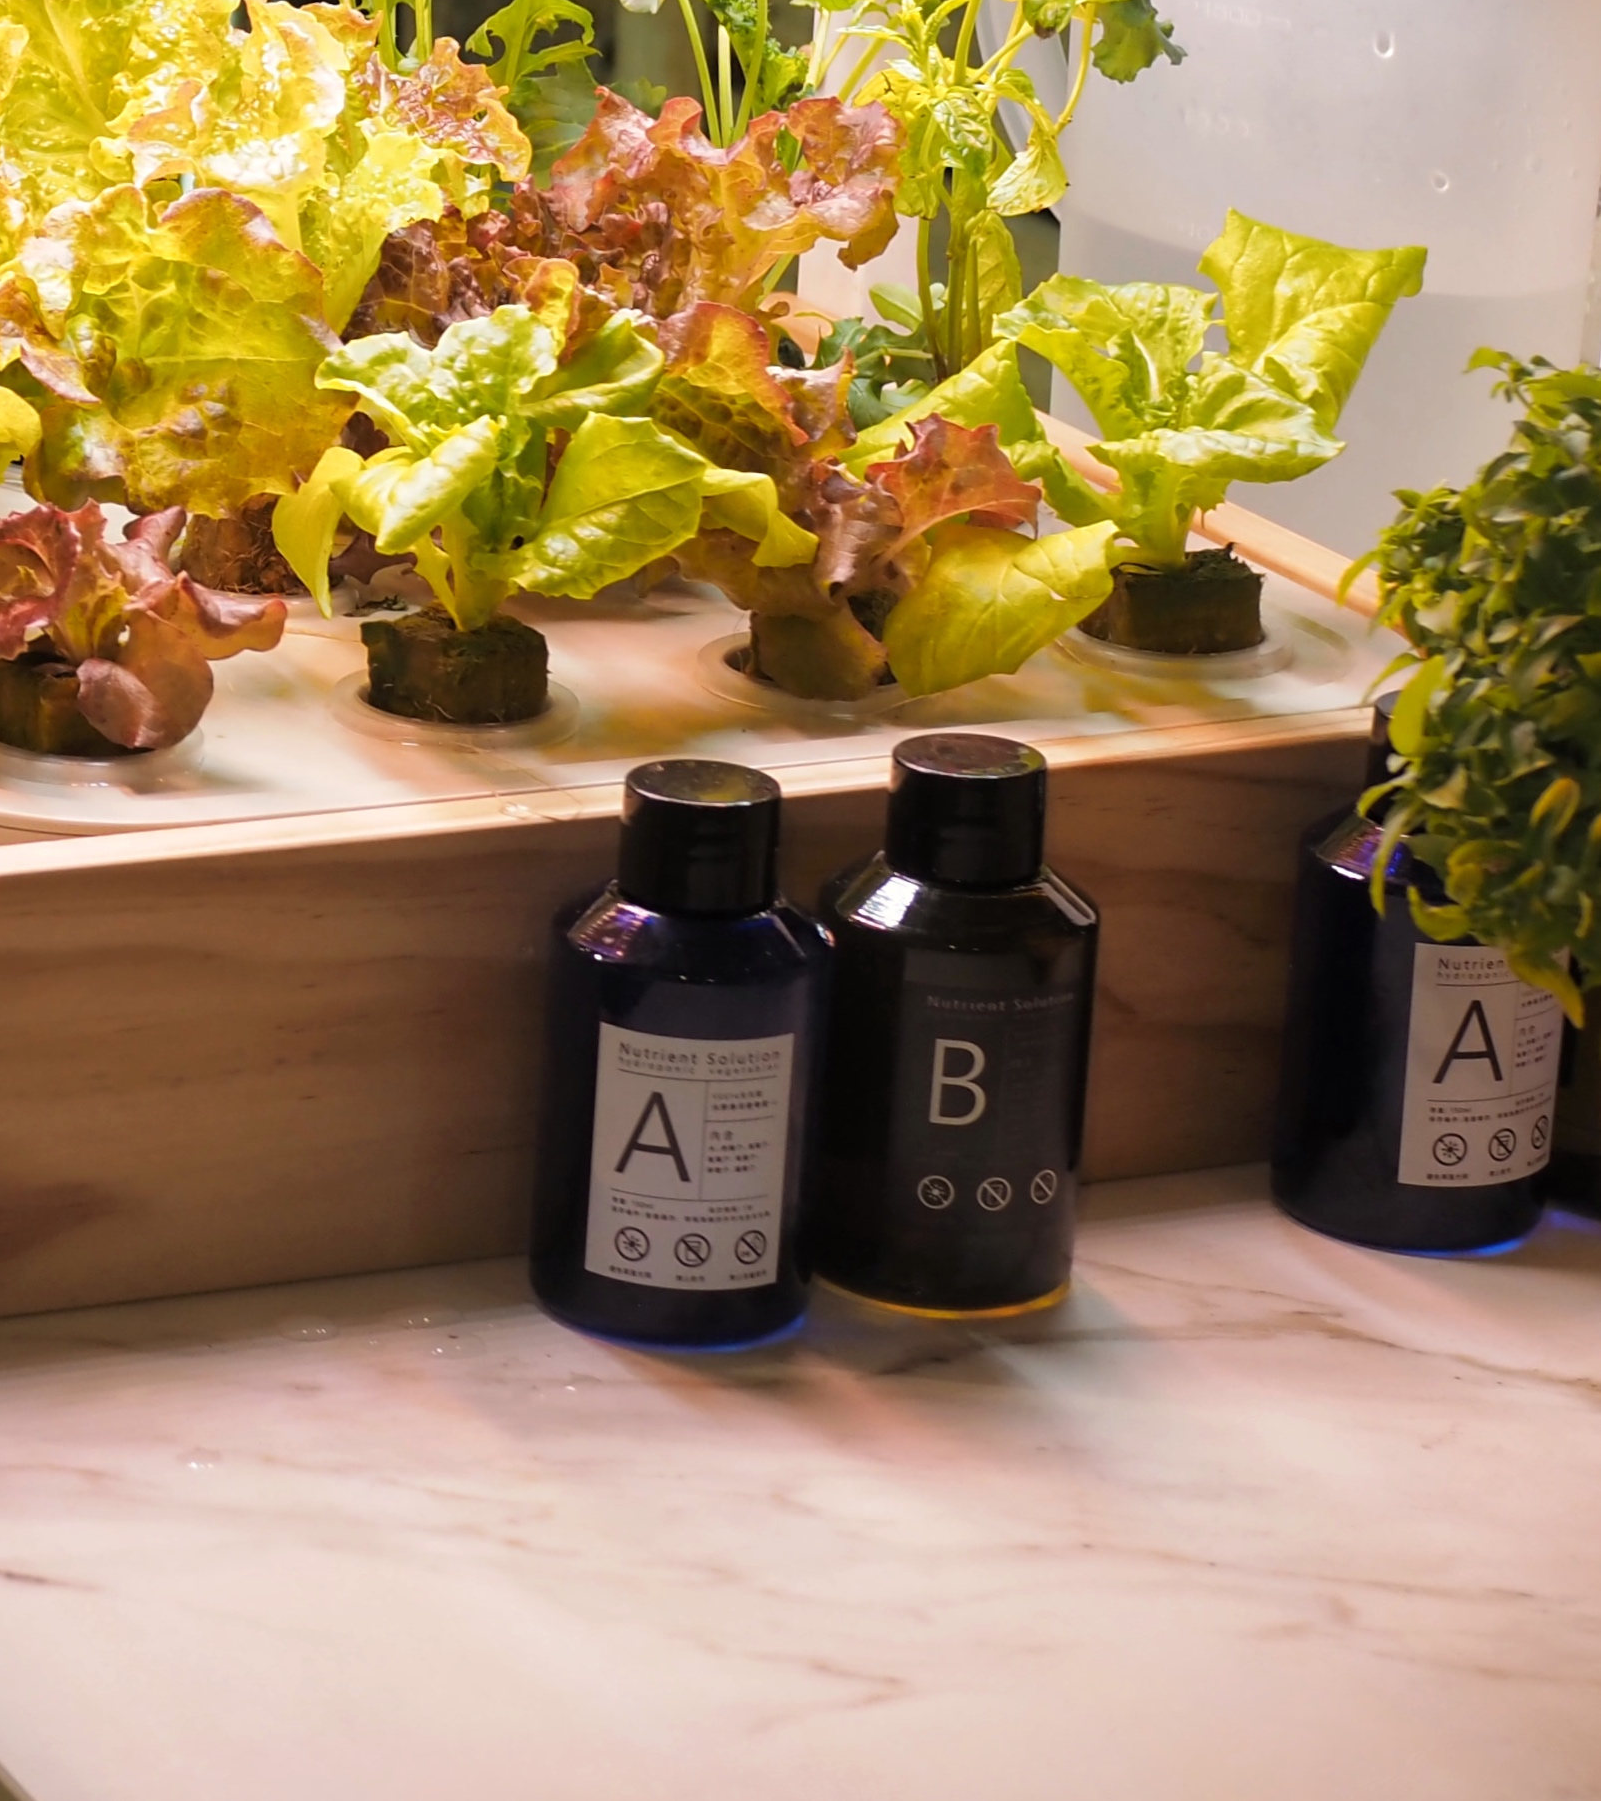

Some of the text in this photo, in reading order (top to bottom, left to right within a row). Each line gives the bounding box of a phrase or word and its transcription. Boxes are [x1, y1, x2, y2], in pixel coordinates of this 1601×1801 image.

[1437, 957, 1505, 971] Nutrien
[927, 995, 1007, 1012] Nutrient
[618, 1042, 781, 1066] Nutrient Solution
[1432, 999, 1503, 1084] A
[929, 1037, 987, 1126] B
[614, 1090, 691, 1183] A
